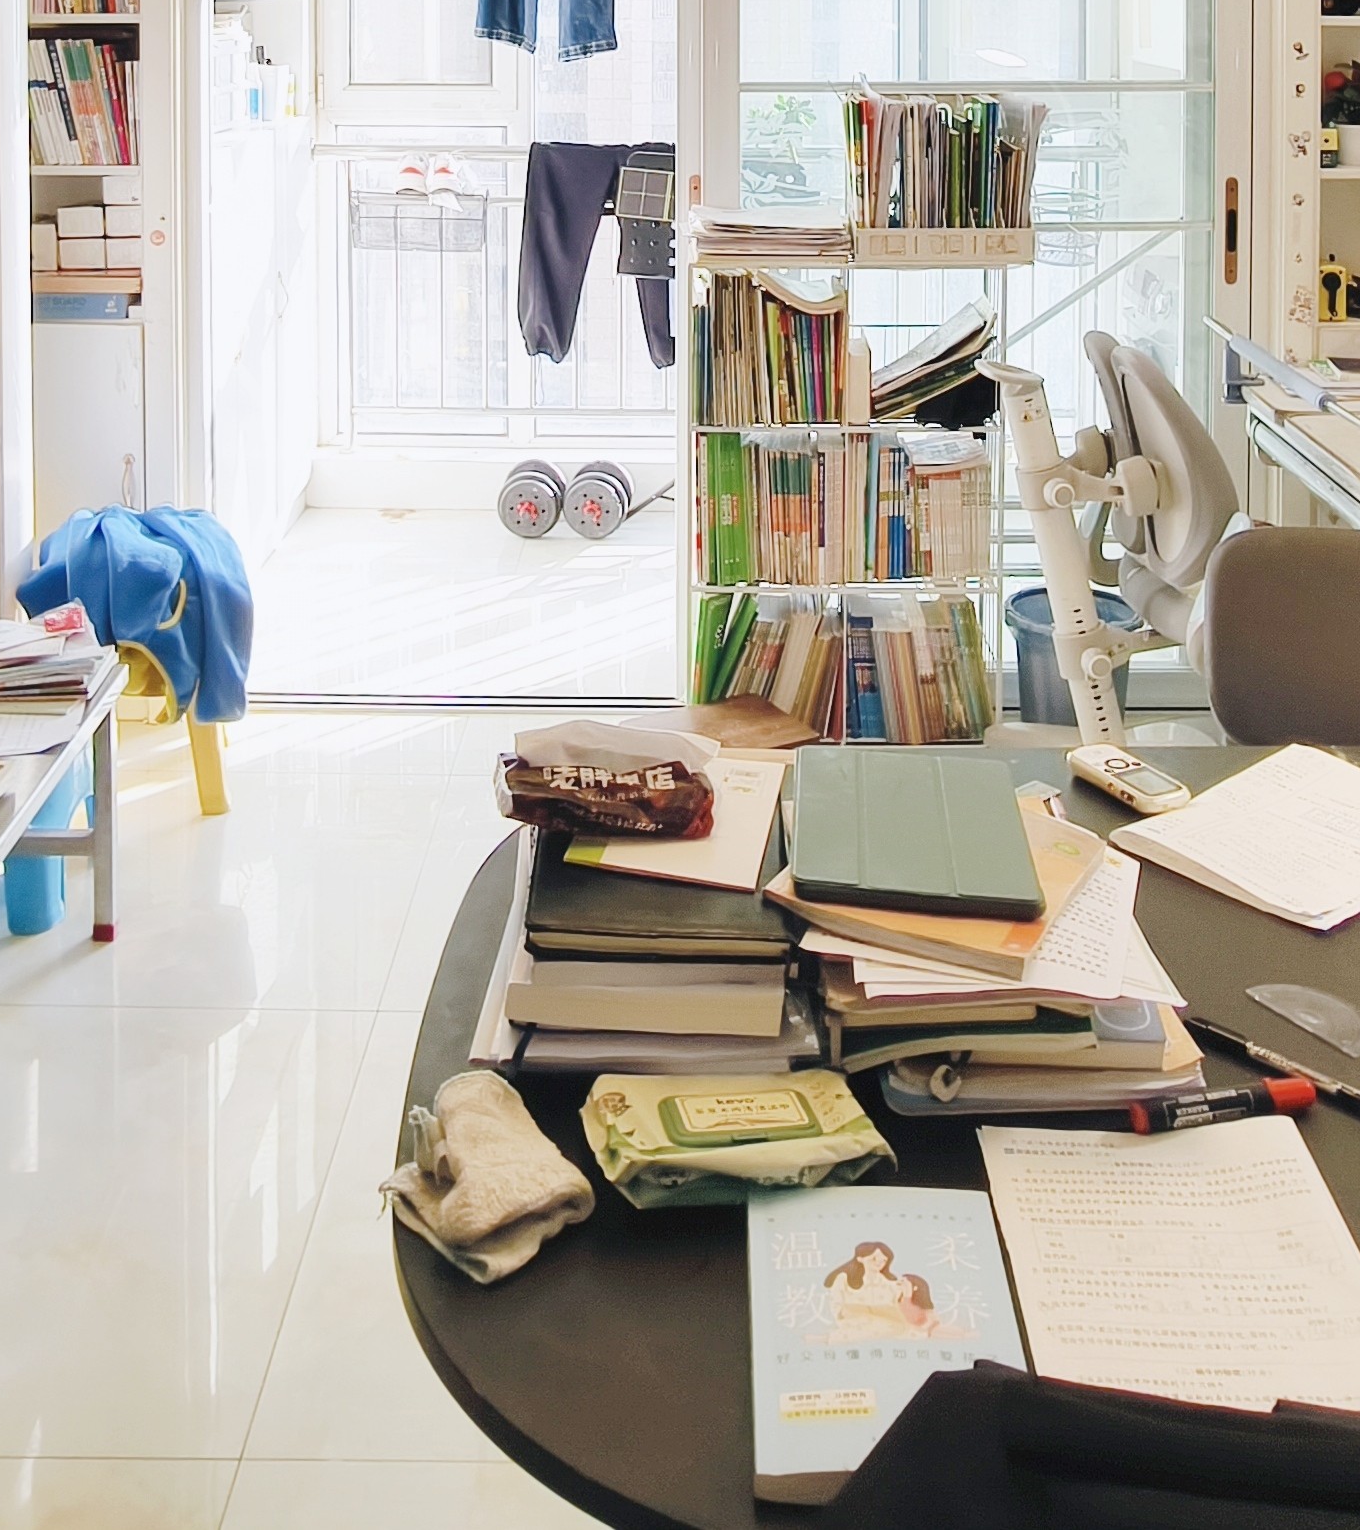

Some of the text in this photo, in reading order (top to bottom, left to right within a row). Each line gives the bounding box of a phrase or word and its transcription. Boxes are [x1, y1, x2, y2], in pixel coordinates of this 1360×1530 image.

[770, 1231, 982, 1271] 温 柔
[776, 1282, 991, 1329] 教 养
